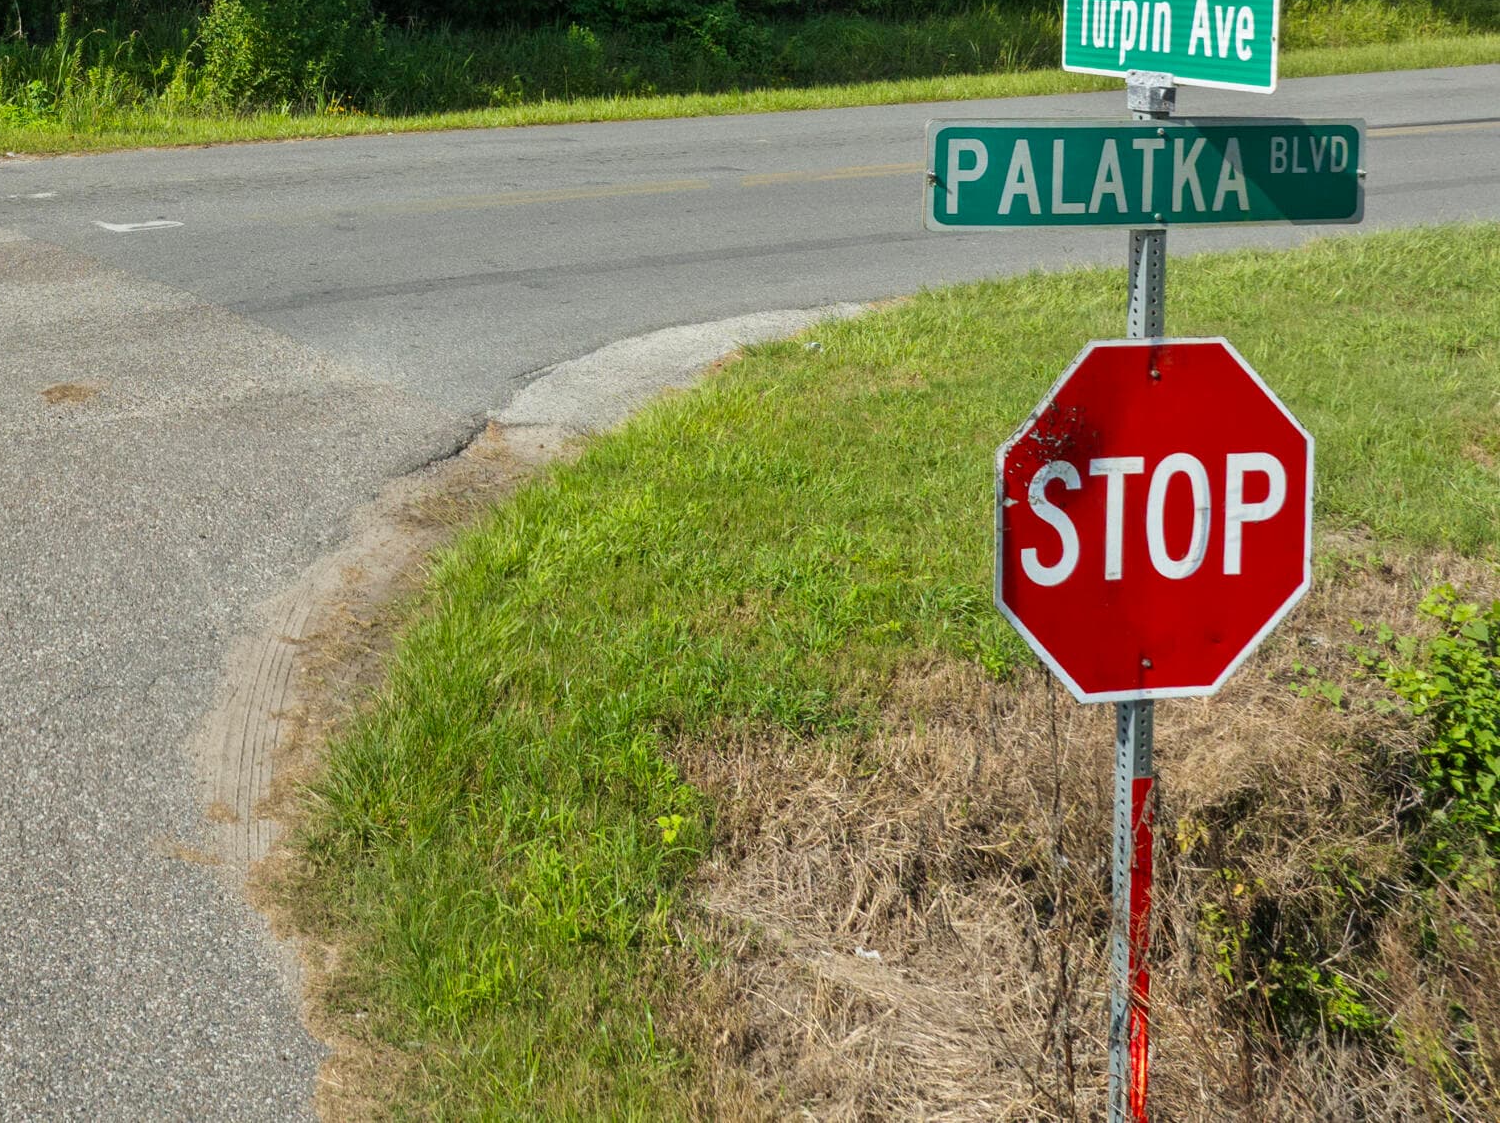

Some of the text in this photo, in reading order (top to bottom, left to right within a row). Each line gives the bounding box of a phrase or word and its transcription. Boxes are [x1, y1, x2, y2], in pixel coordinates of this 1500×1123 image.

[945, 134, 1349, 215] PALATKA BLVD
[1019, 451, 1288, 588] STOP
